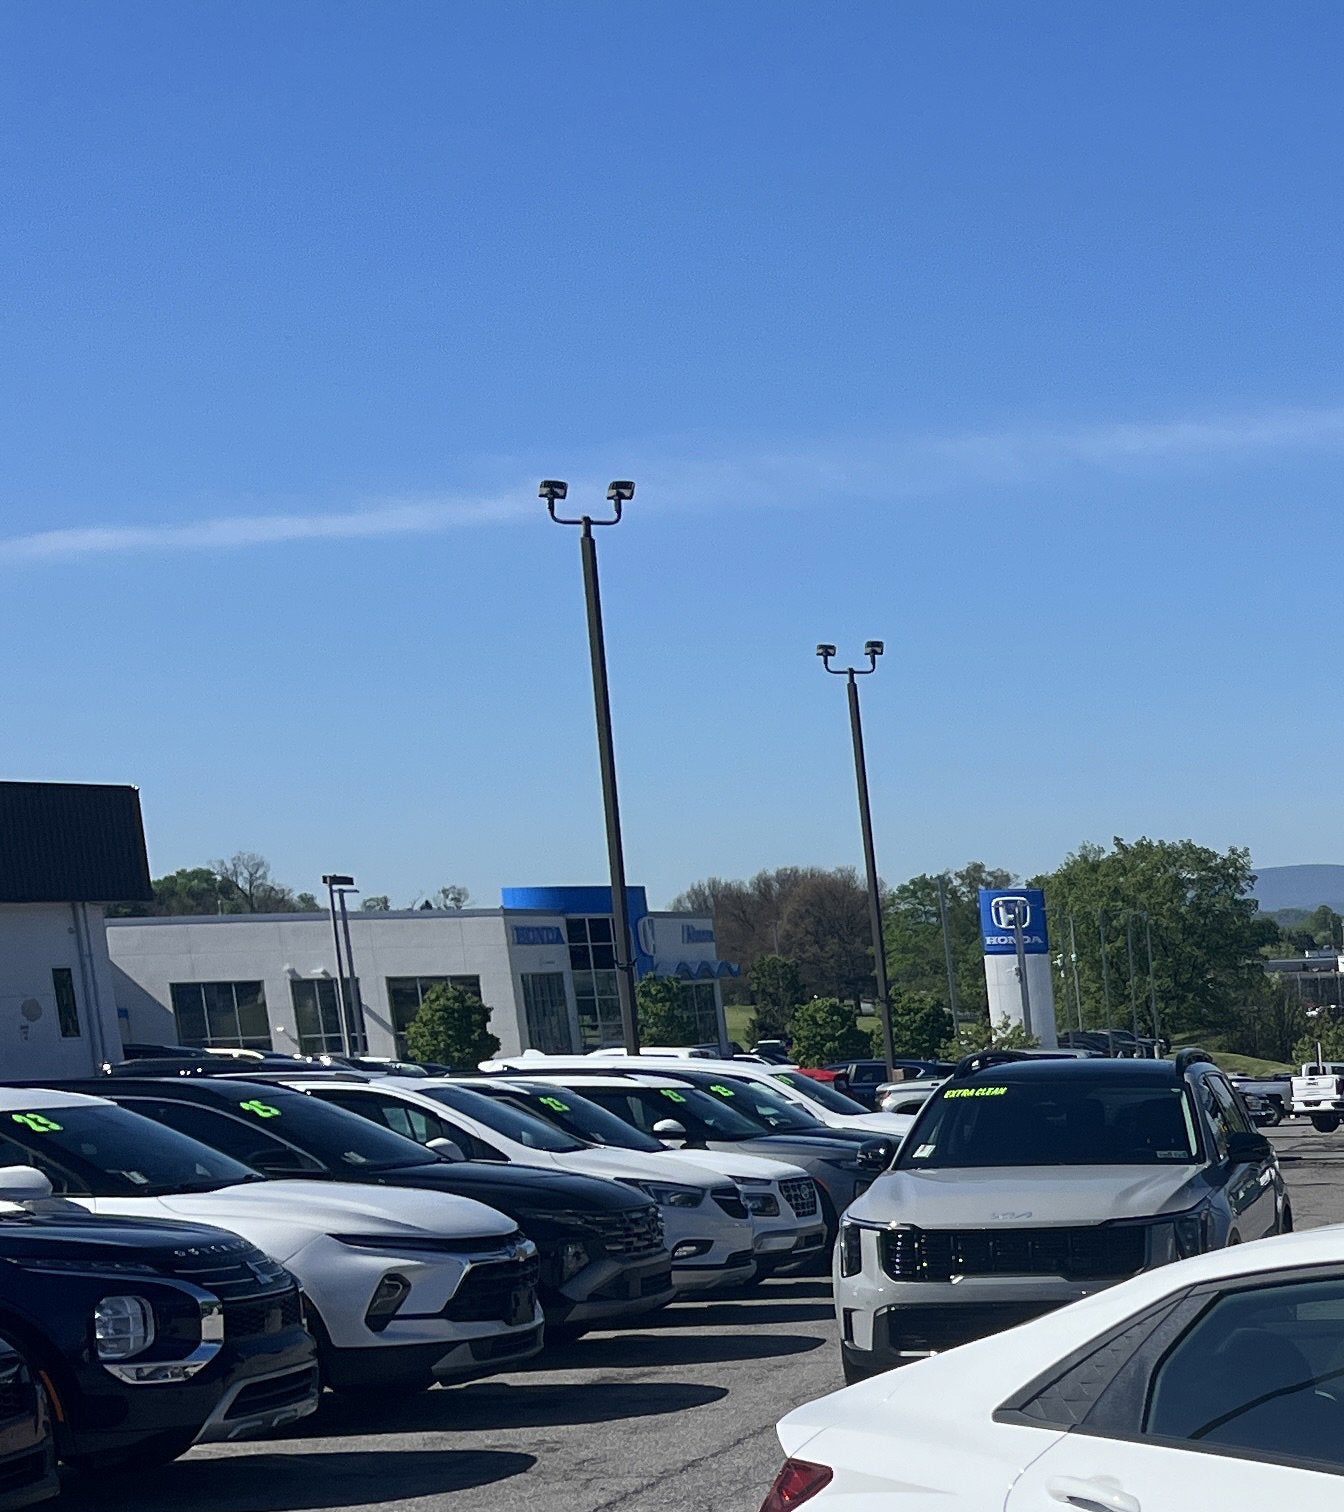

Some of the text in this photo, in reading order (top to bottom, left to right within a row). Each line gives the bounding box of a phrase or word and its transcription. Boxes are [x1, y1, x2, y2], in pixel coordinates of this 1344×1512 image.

[944, 1087, 1007, 1099] EXTRA CLEAN
[11, 1113, 64, 1132] 23
